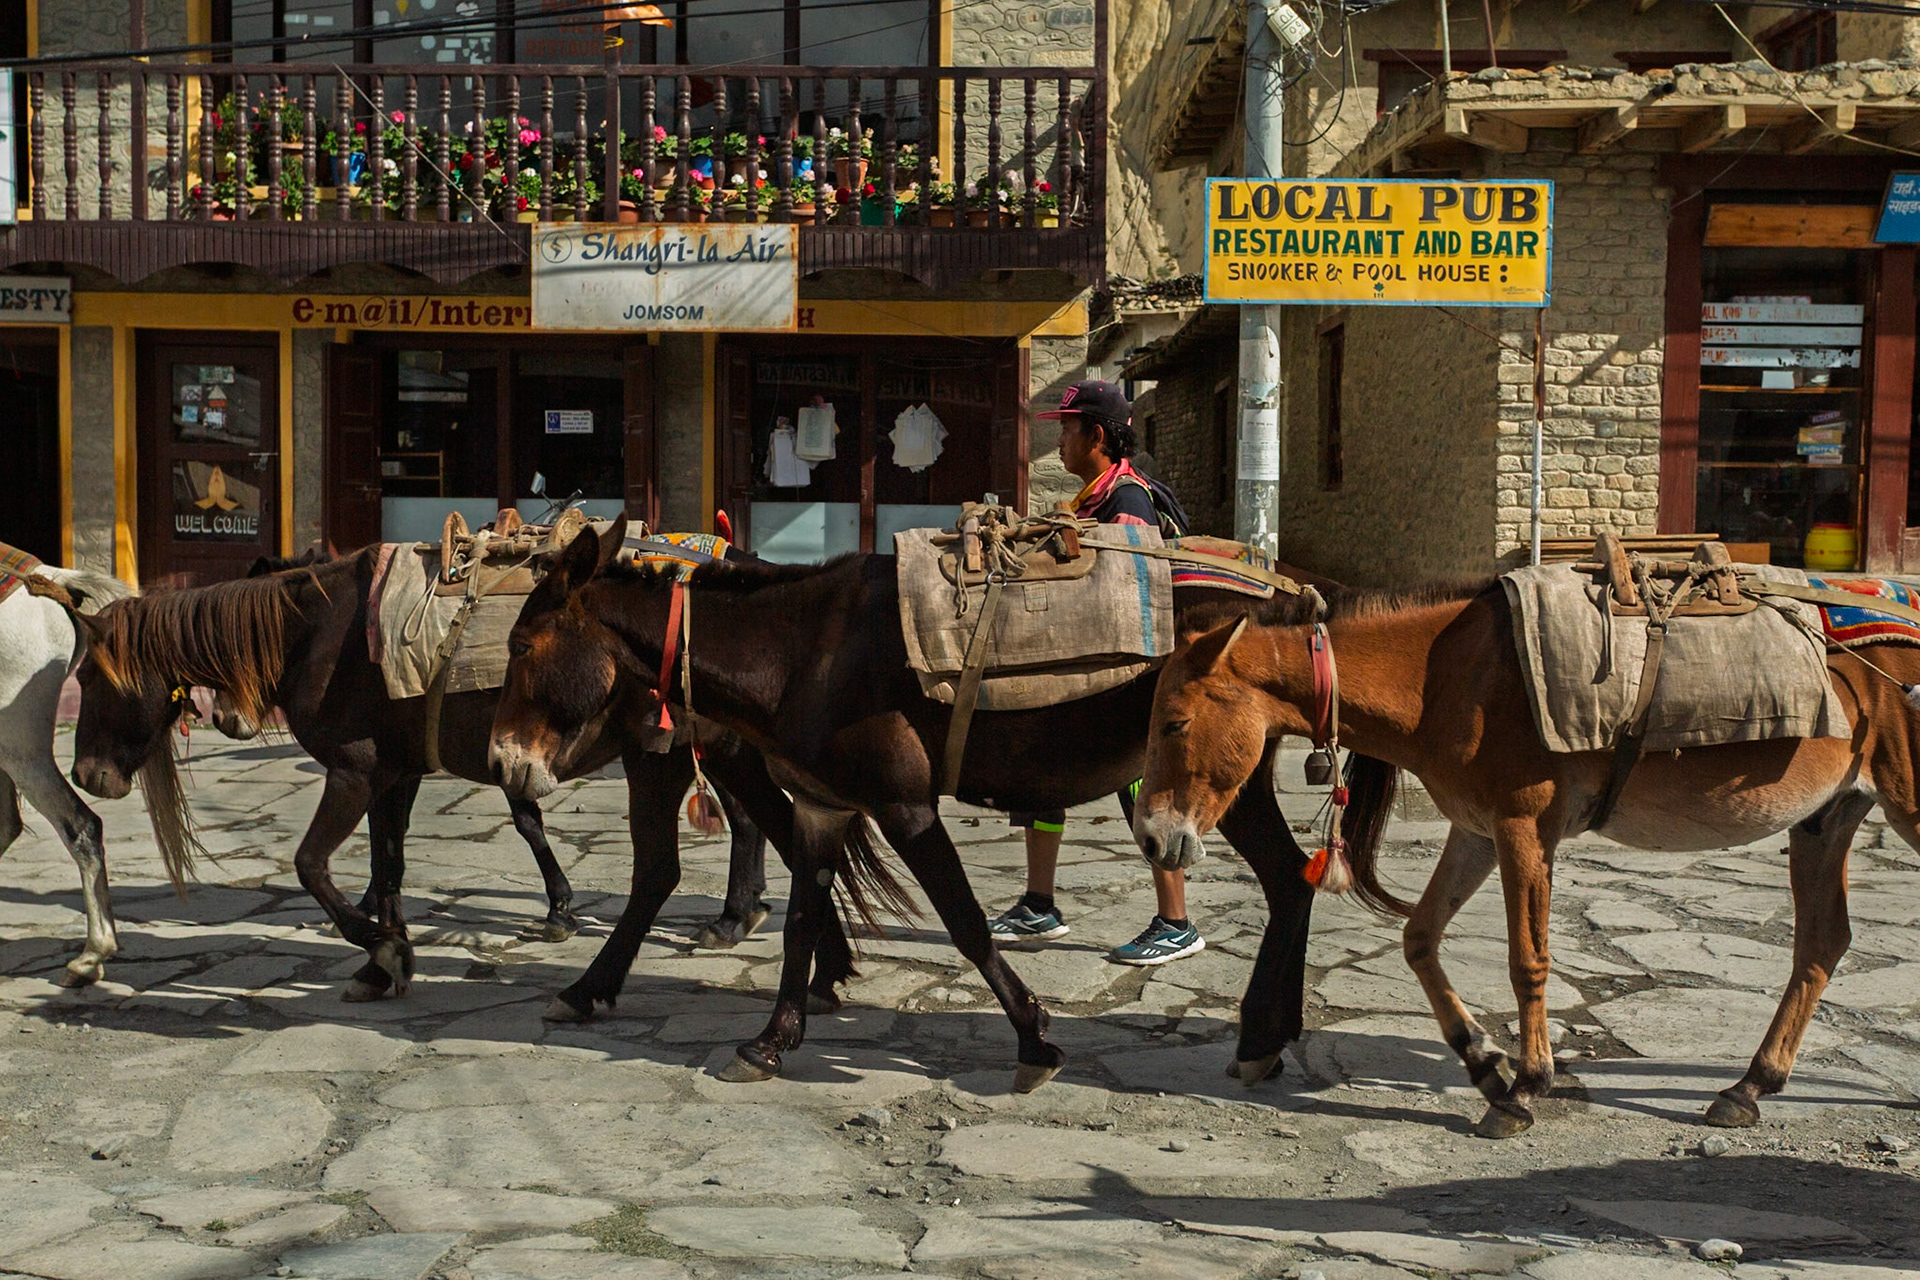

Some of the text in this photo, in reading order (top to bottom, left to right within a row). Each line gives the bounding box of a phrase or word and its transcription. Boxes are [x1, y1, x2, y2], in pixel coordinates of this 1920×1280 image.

[525, 39, 635, 57] RESTAURT
[1217, 184, 1541, 224] LOCAL PUB
[581, 232, 785, 275] Shangri-la Air
[1212, 228, 1540, 260] RESTAURANT AND BAR
[1227, 262, 1319, 283] SNOOKER
[1325, 262, 1343, 285] &
[1352, 262, 1407, 282] POOL
[623, 304, 704, 321] JOMSOM
[175, 514, 259, 535] WELCOME
